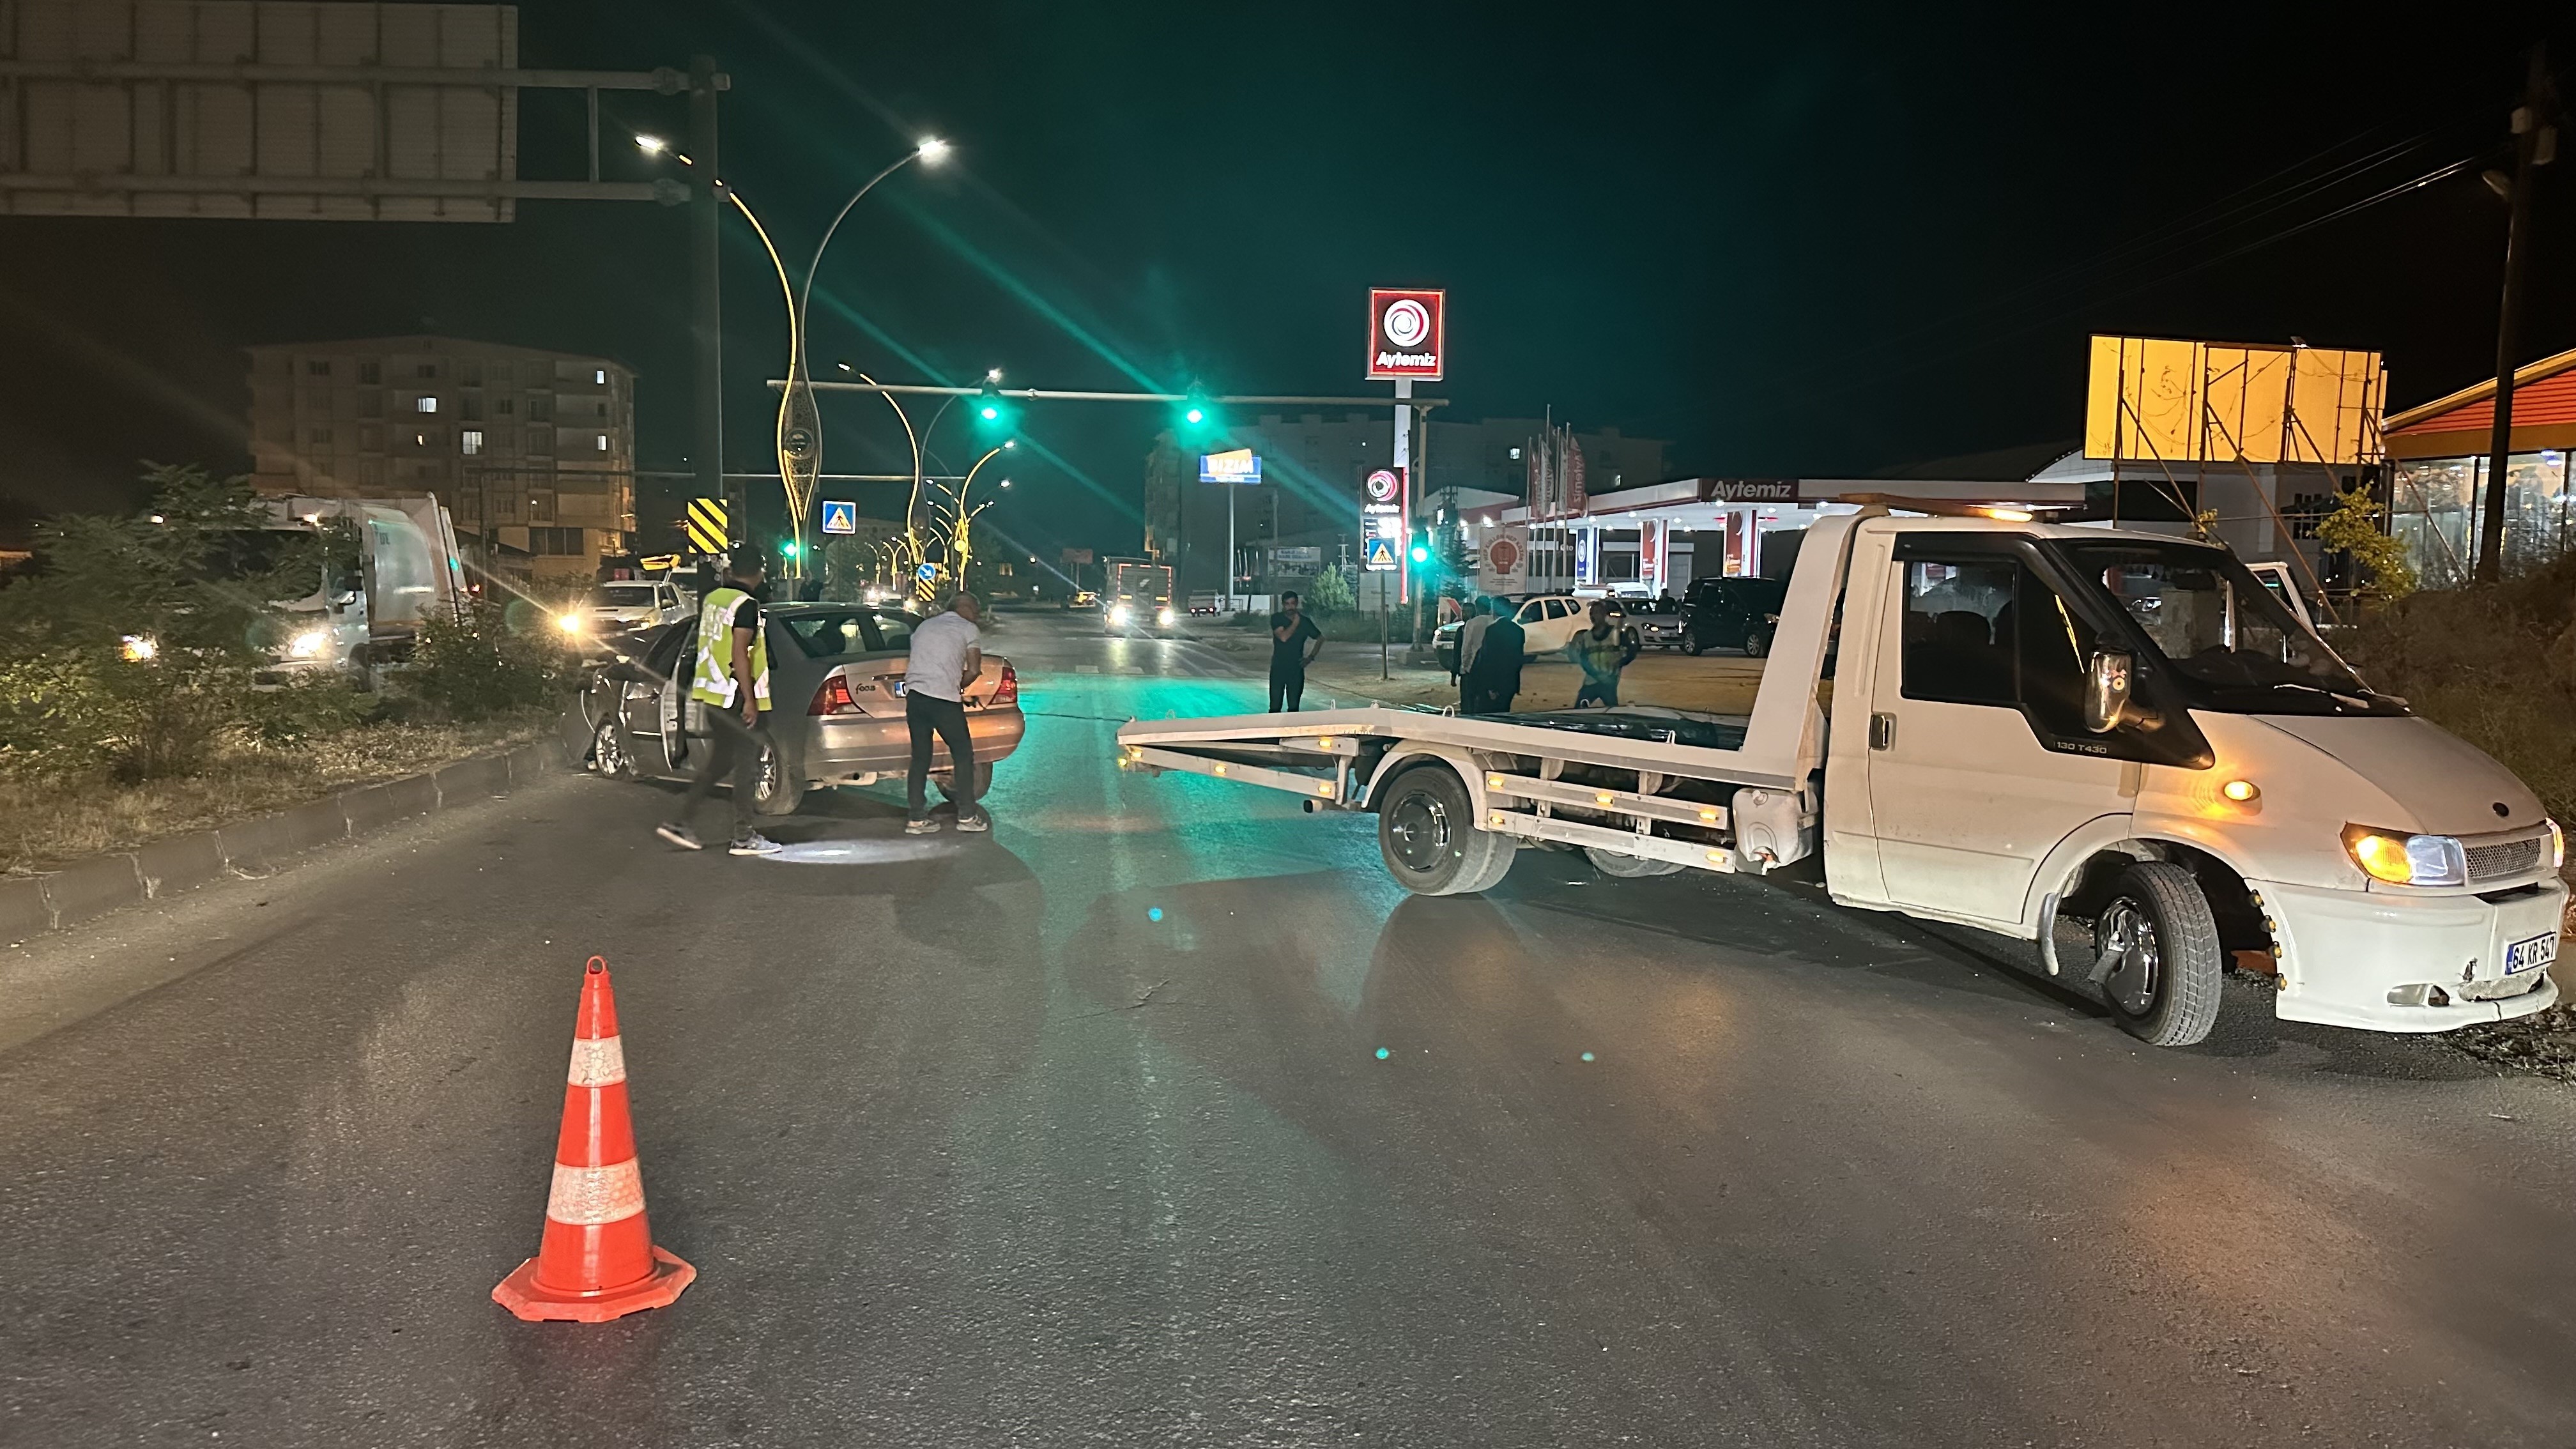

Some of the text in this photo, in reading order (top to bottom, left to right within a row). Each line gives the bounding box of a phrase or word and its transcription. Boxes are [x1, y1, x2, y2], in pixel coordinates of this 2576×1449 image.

[1376, 351, 1437, 369] Aytemiz
[1710, 480, 1791, 500] Aytemiz
[2057, 741, 2107, 754] 130 T430
[2513, 936, 2554, 969] 64 KR 547
